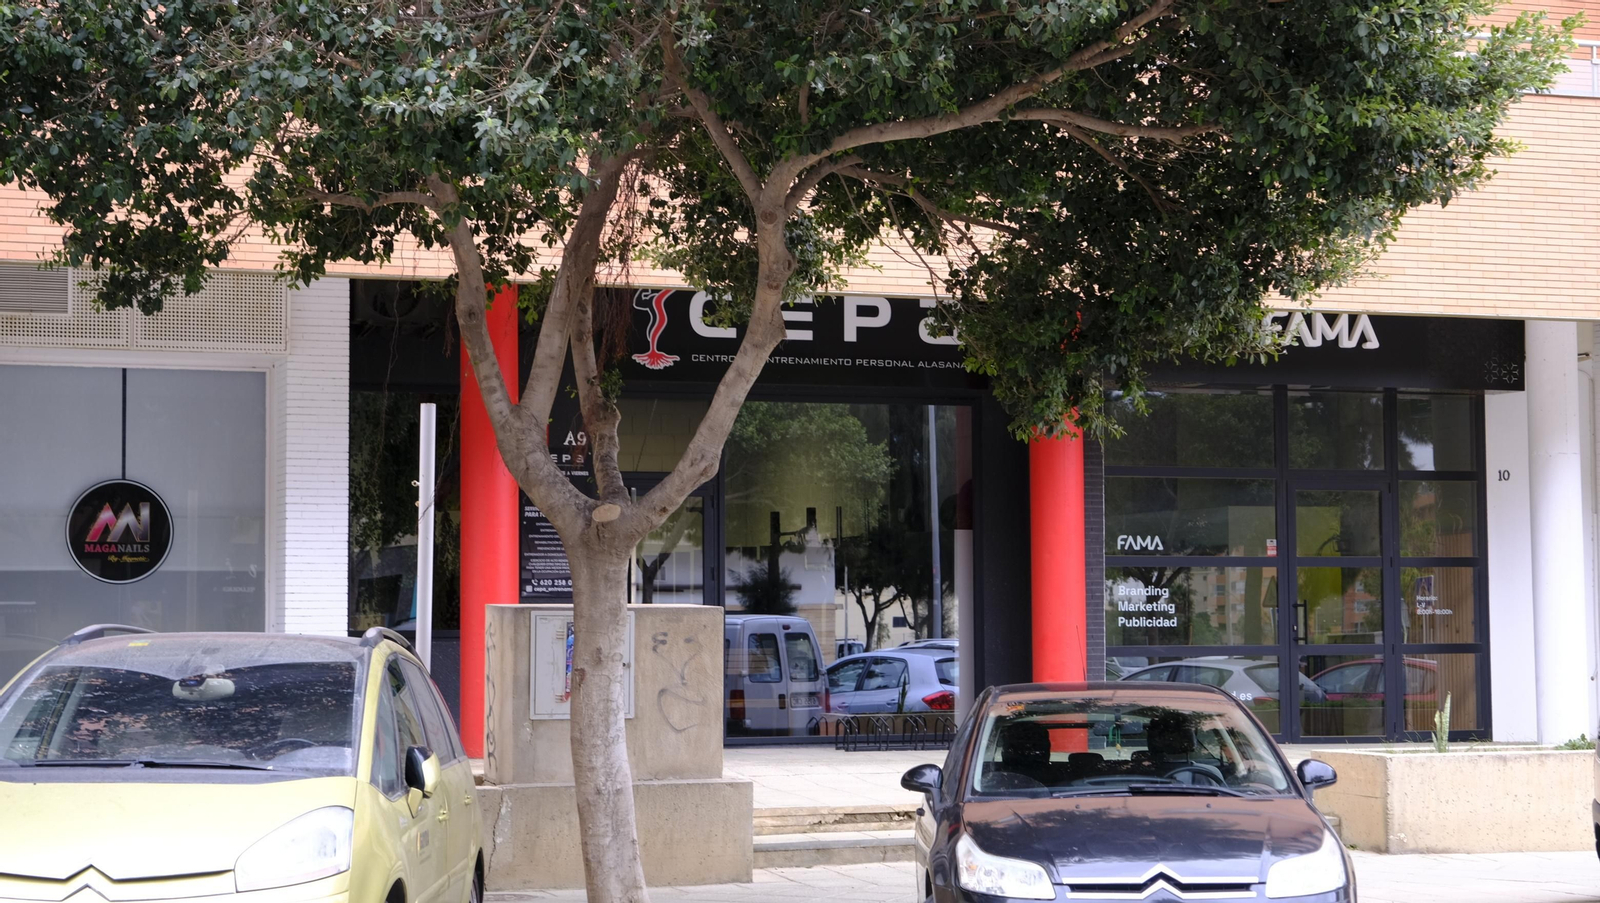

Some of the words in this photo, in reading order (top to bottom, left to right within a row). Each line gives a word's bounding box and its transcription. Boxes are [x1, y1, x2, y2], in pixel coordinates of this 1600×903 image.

[1261, 310, 1380, 349] FAMA
[691, 354, 737, 363] CENTRO
[766, 356, 852, 366] NTRENAMIENTO
[856, 359, 914, 368] PERSONAL
[563, 430, 587, 446] A9
[1497, 469, 1511, 482] 10
[84, 544, 150, 552] MAGANAILS
[1117, 535, 1164, 550] FAMA
[1118, 586, 1169, 598] Branding
[1118, 601, 1176, 614] Marketing
[1118, 617, 1178, 628] Publicidad
